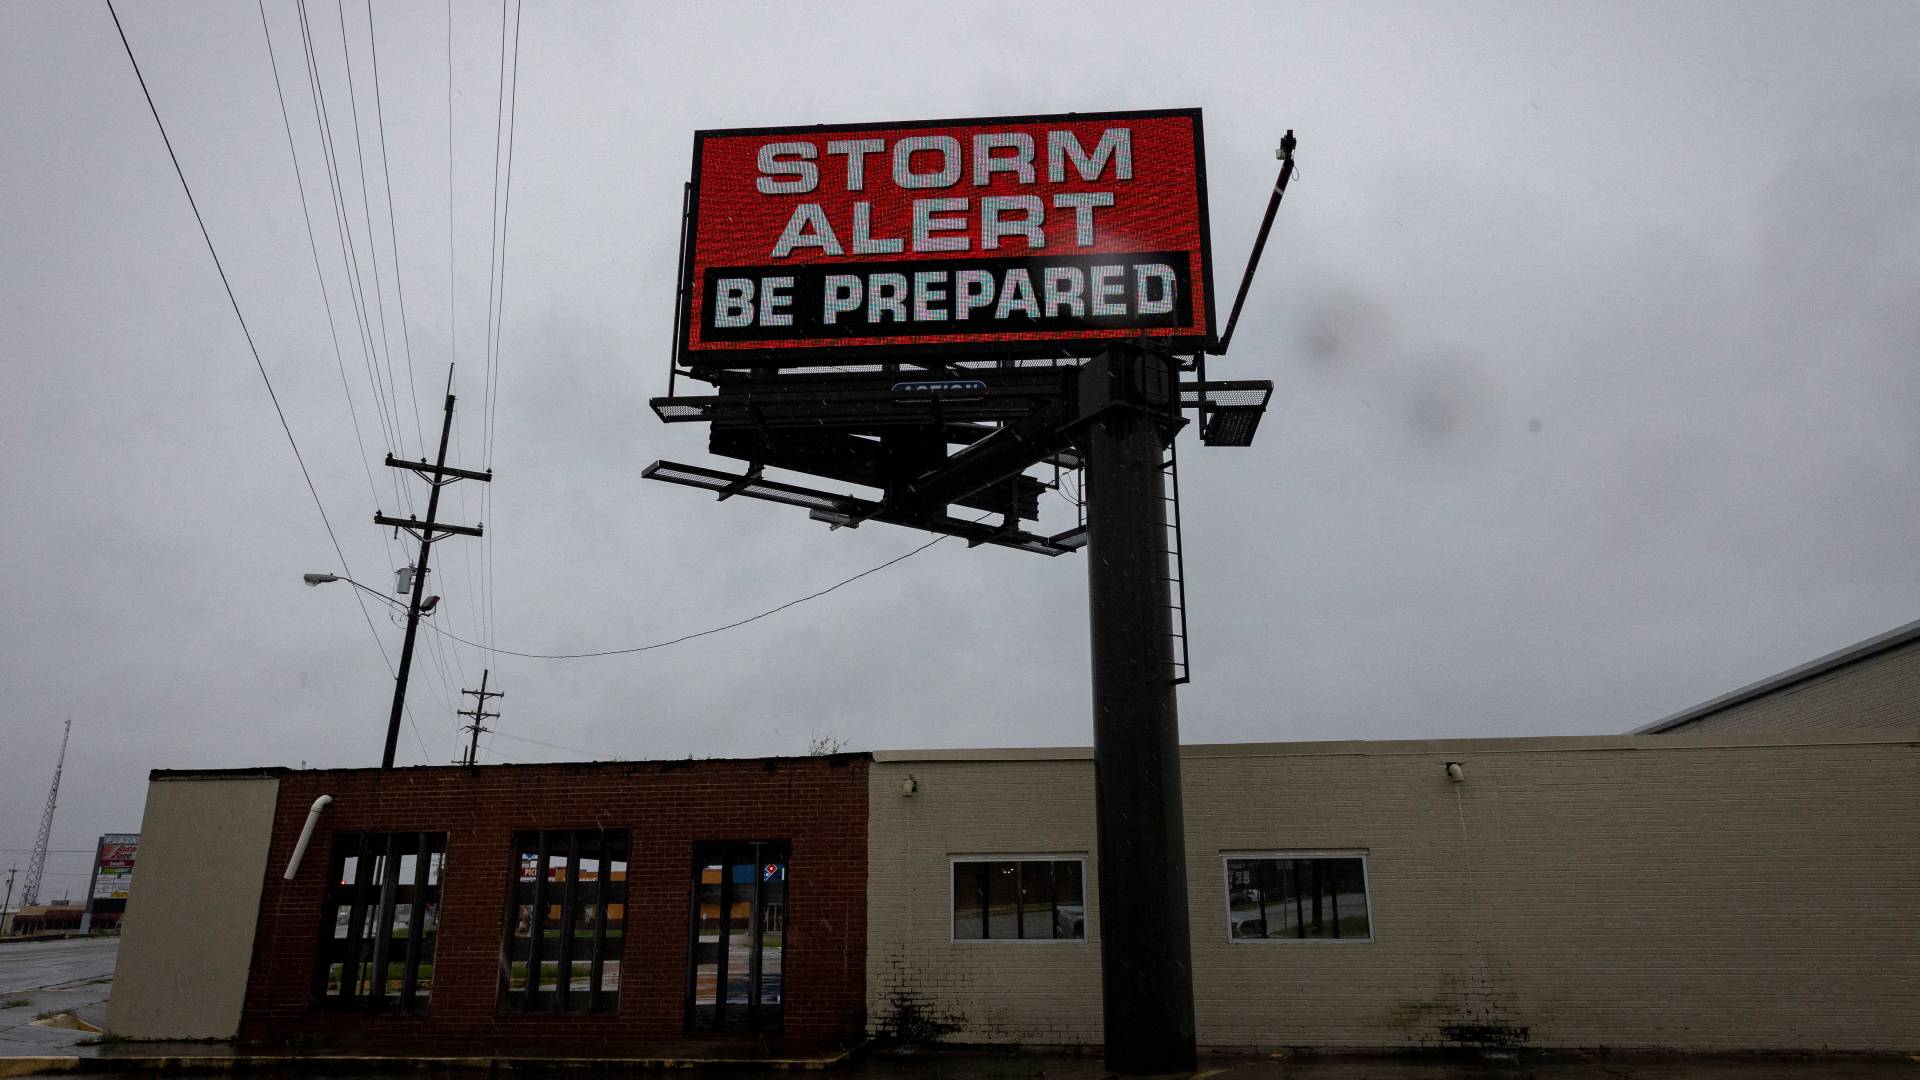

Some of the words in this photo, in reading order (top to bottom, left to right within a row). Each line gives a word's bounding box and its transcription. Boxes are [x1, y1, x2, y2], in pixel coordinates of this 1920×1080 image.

[757, 128, 1132, 194] STORM
[770, 192, 1115, 257] ALERT
[714, 277, 794, 328] BE
[823, 263, 1177, 325] PREPARED
